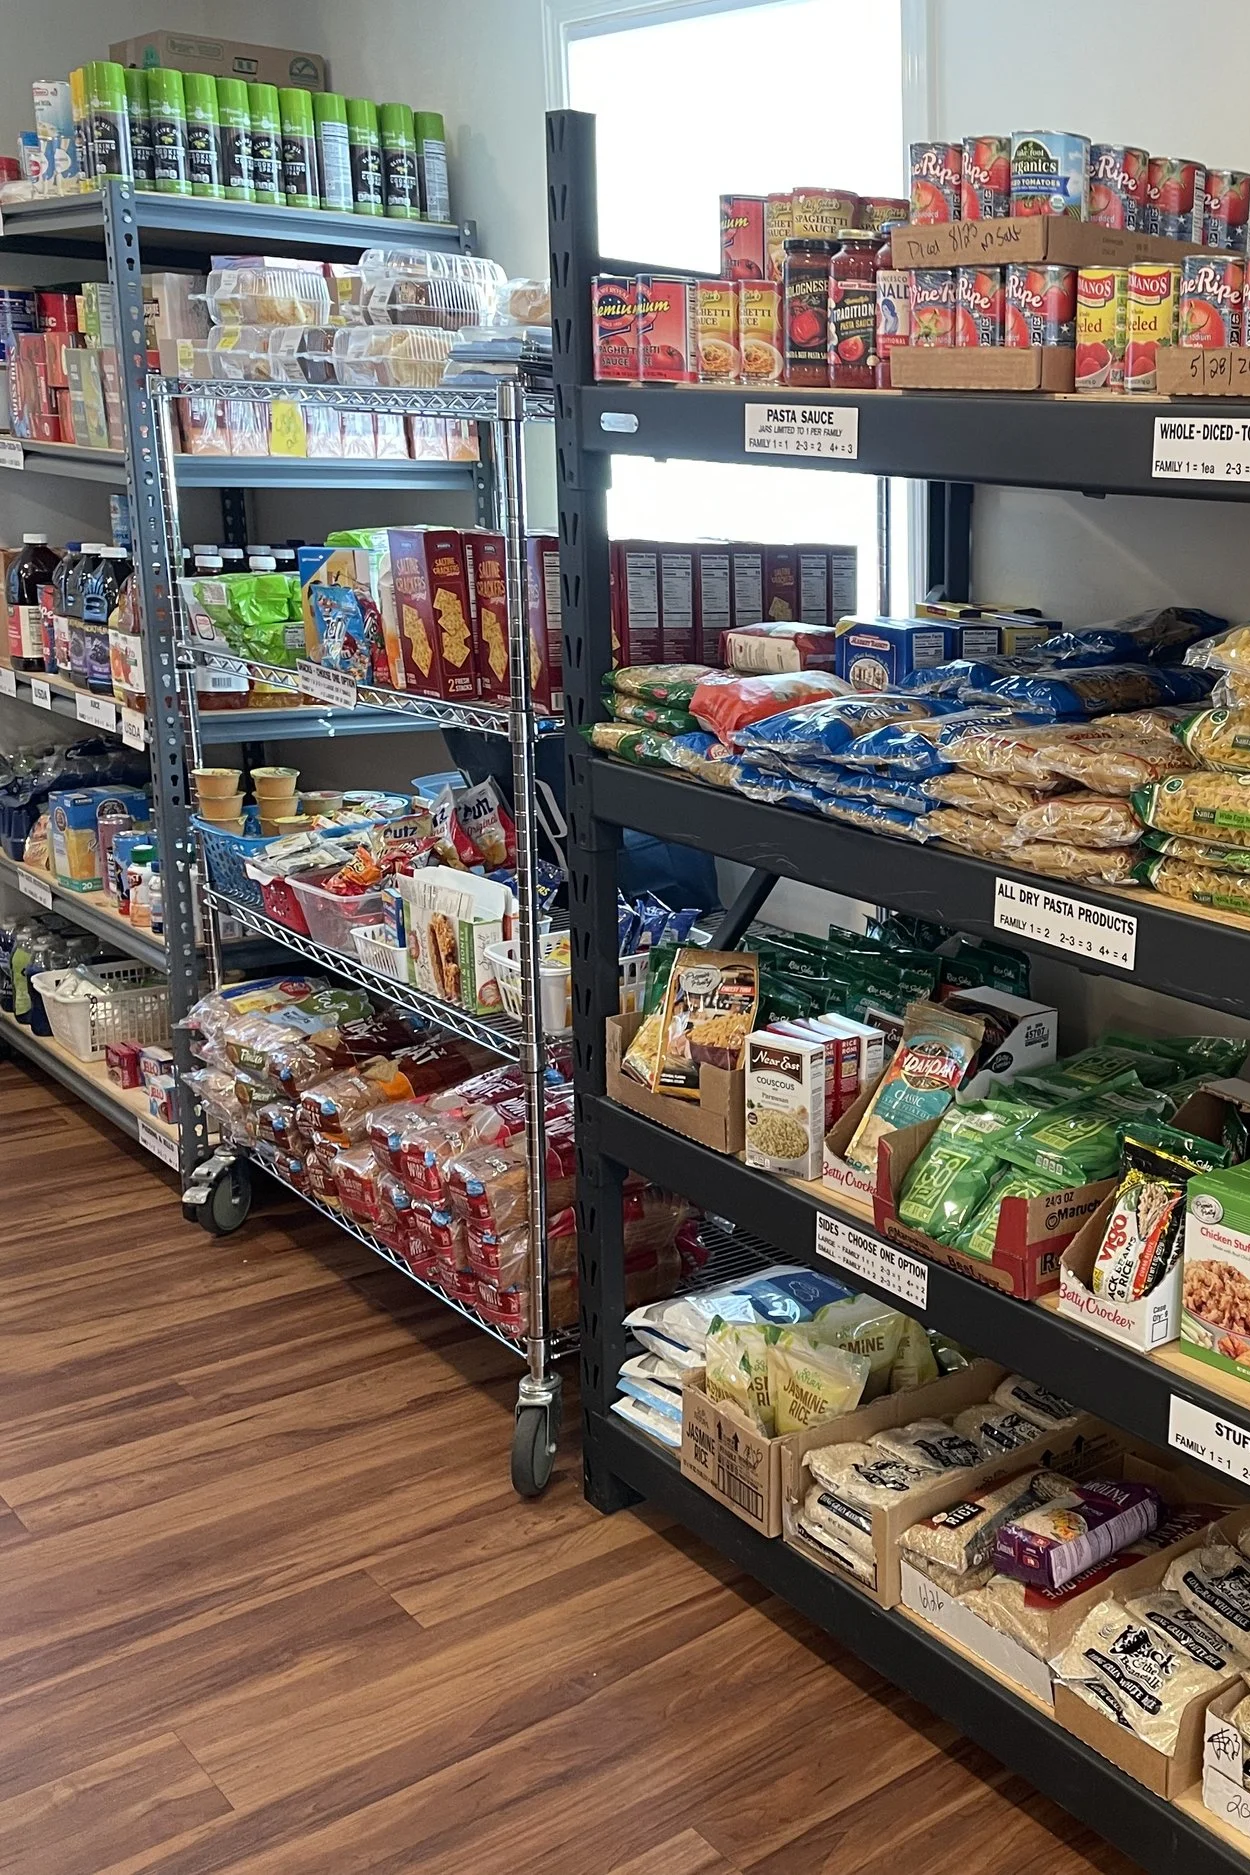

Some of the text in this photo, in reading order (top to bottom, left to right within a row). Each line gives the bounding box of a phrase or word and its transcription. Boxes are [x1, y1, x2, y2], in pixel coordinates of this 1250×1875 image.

[794, 215, 848, 228] SPAGHETTI
[802, 223, 838, 234] SAUCE
[767, 409, 834, 425] PASTA SAUCE
[758, 425, 772, 433] JARS
[774, 426, 795, 435] LIMITED
[797, 427, 804, 435] TO
[811, 428, 821, 436] PER
[823, 428, 843, 437] FAMILY
[1155, 460, 1183, 473] FAMILY
[1201, 462, 1215, 474] 1ea
[1226, 463, 1242, 475] 2-3
[124, 721, 141, 738] USDA
[997, 883, 1134, 936] ALL DRY PASTA PRODUCTS
[756, 1076, 795, 1092] COUSCOUS
[1200, 1226, 1232, 1248] Chicken
[818, 1216, 839, 1237] SIDES
[847, 1231, 878, 1256] CHOOSE
[879, 1247, 896, 1265] ONE
[897, 1256, 926, 1281] OPTION
[1059, 1282, 1133, 1331] Betty Crocker
[783, 1377, 828, 1413] JASMINE
[788, 1399, 811, 1425] RICE
[1175, 1433, 1207, 1456] FAMILY
